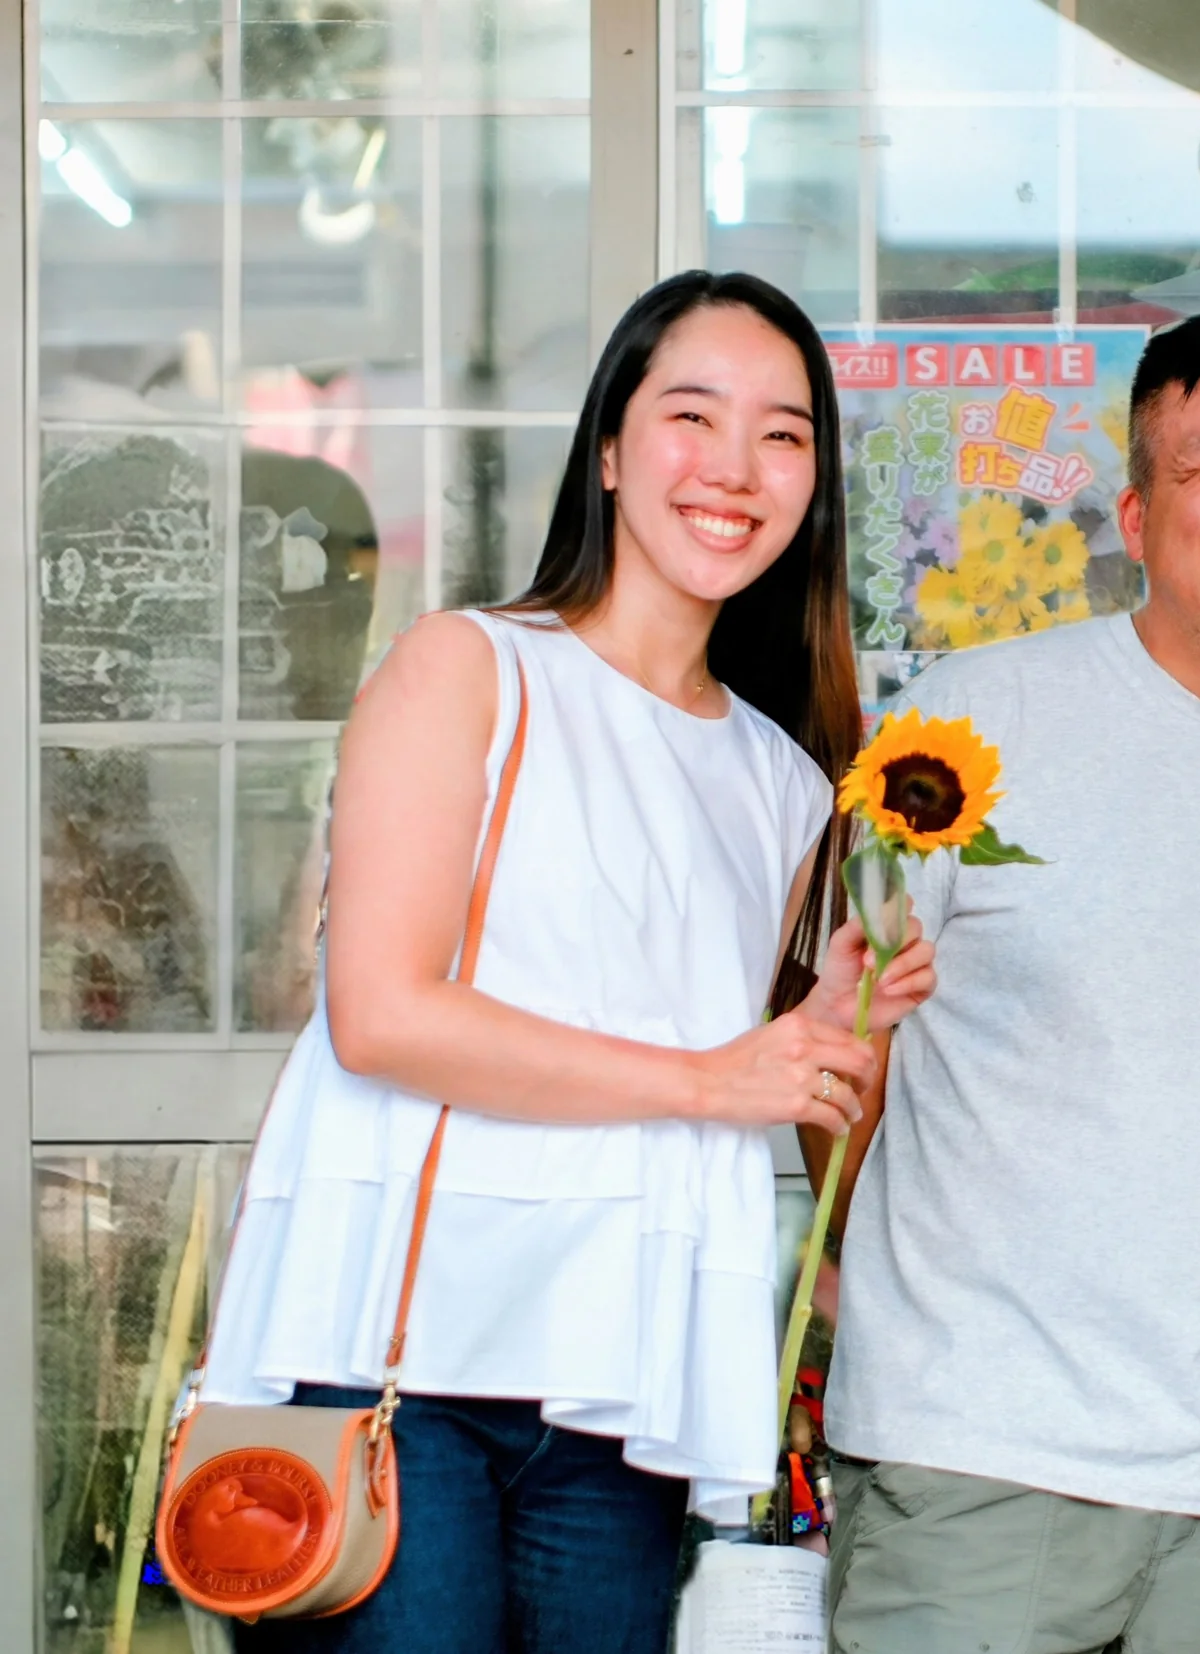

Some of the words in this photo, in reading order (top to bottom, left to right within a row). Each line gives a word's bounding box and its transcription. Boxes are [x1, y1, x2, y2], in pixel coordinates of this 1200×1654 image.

[914, 346, 1084, 380] SALE
[909, 391, 950, 495] 花束が
[961, 387, 1056, 451] お値
[961, 443, 1090, 500] 打ち品!!
[863, 426, 906, 644] 盛りたくさん
